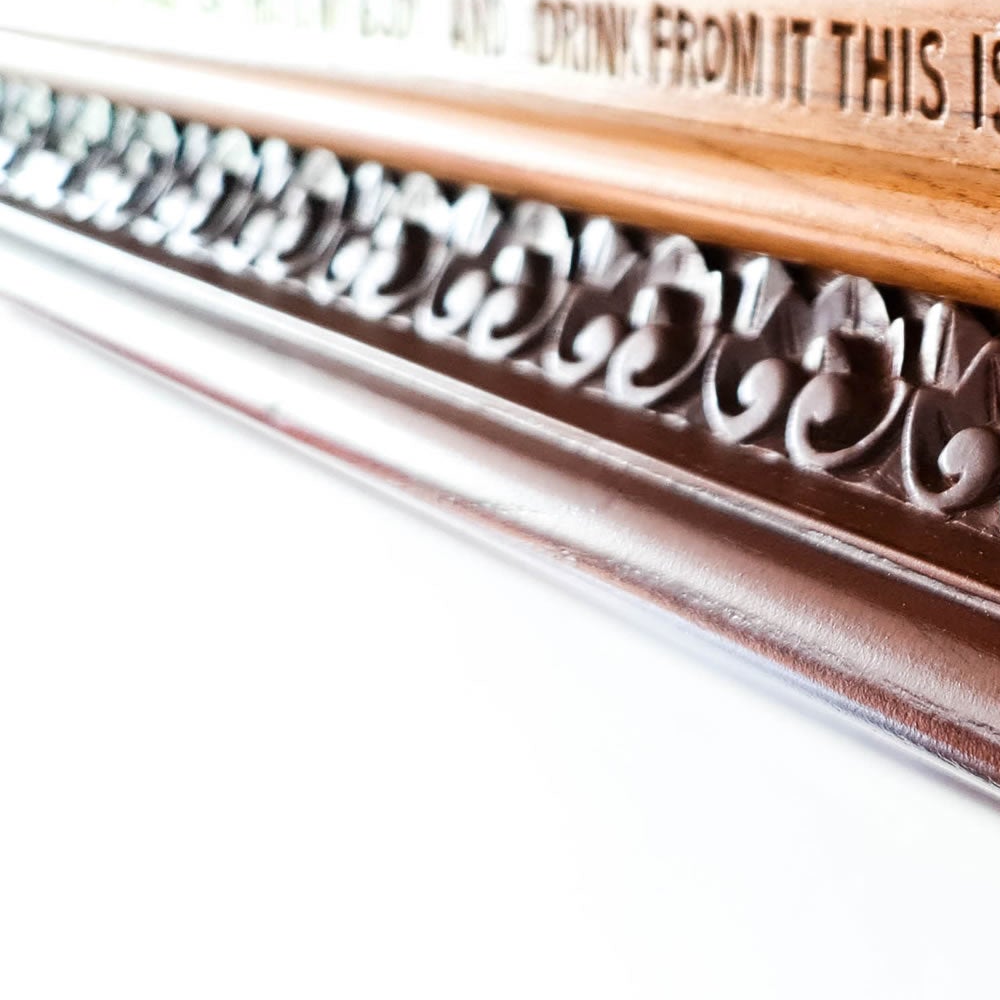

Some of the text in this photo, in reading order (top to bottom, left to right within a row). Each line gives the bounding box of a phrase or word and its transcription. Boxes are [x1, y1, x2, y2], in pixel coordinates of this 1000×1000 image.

[650, 3, 763, 97] FROM
[772, 15, 814, 107] IT
[830, 21, 949, 121] THIS
